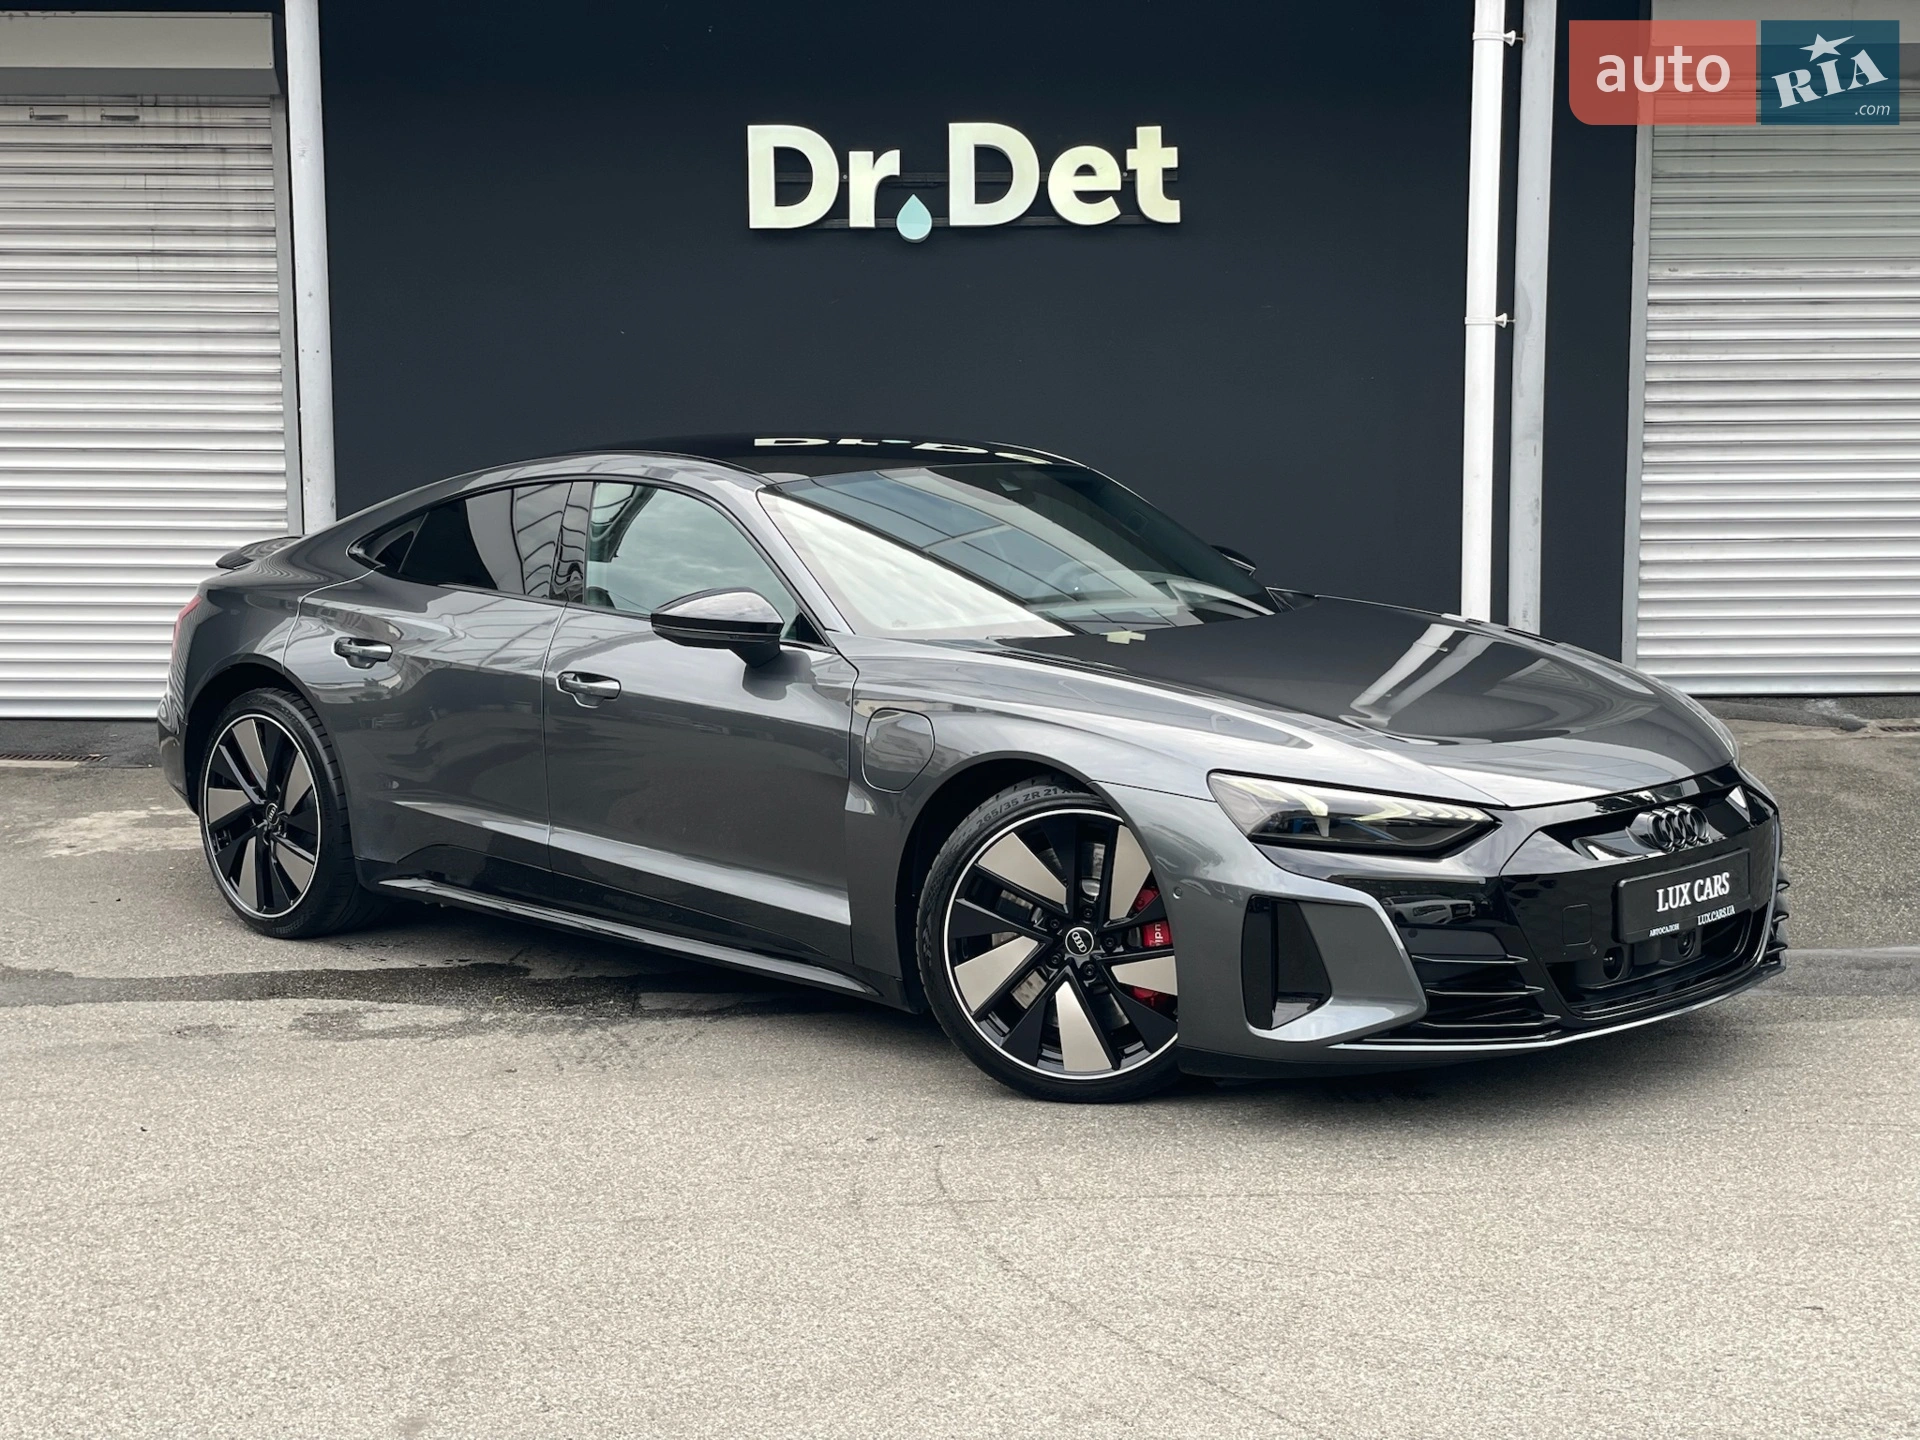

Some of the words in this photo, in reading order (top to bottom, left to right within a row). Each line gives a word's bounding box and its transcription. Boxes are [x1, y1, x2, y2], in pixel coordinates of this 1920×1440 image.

[976, 798, 1020, 826] 265/35
[1022, 791, 1041, 802] ZR
[1043, 787, 1058, 796] 21
[1656, 882, 1692, 912] LUX
[1693, 872, 1730, 902] CARS
